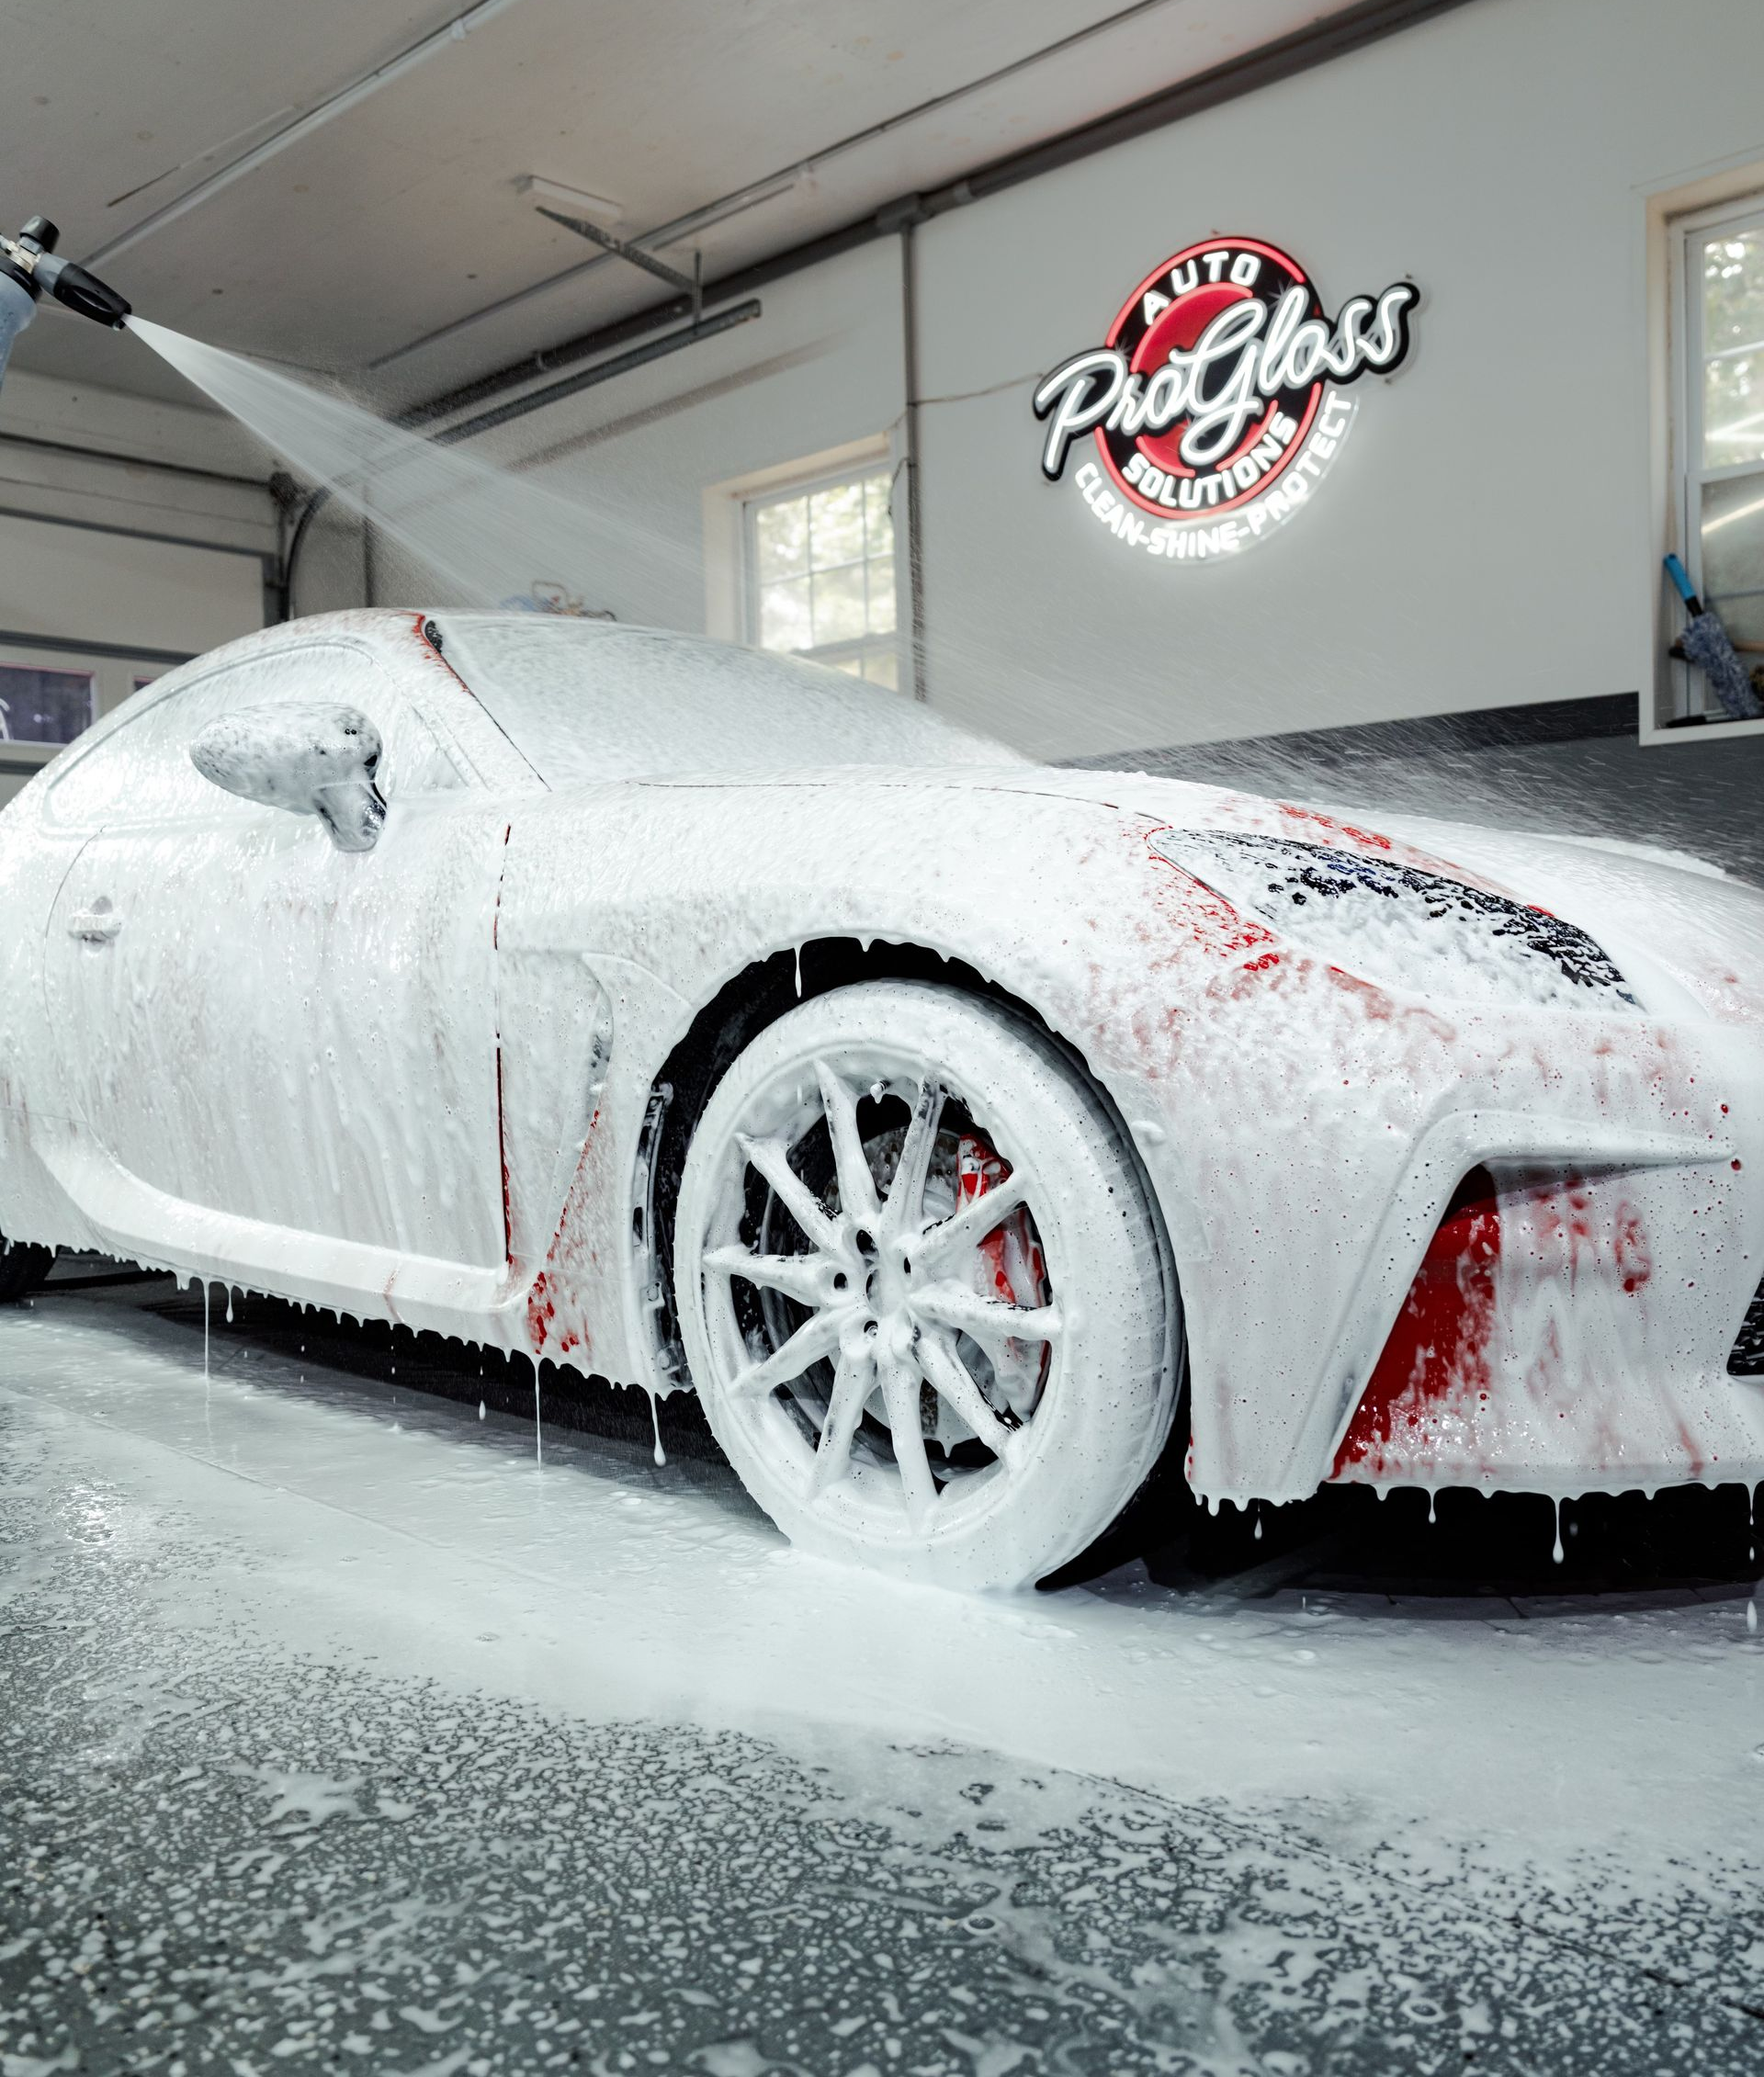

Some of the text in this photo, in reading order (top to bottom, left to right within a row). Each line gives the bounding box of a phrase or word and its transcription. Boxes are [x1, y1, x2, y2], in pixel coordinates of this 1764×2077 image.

[1143, 251, 1261, 325] AUTO
[1035, 284, 1413, 471] ProGloss
[1122, 412, 1297, 508] SOLUTIONS
